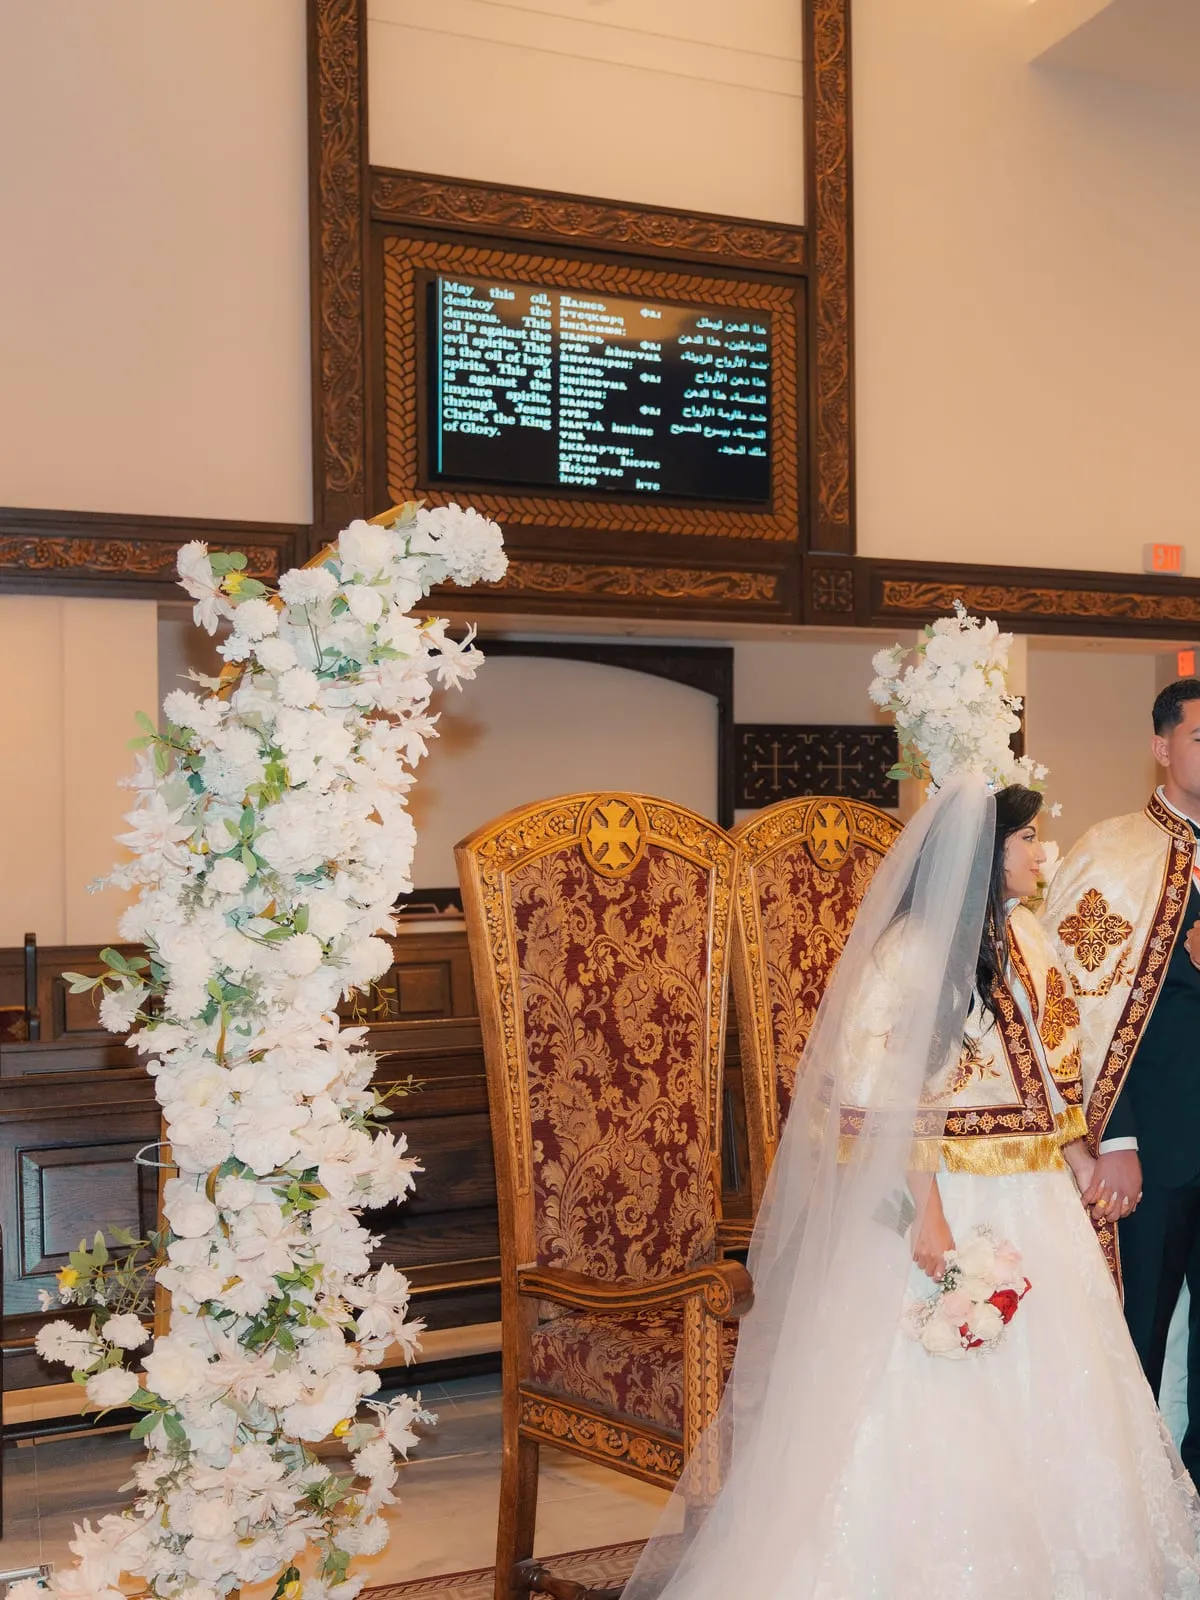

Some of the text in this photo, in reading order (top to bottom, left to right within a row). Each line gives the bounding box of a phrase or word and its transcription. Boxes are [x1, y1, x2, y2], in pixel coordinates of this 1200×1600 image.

[444, 281, 551, 306] May this oil,
[443, 294, 552, 317] destroy the
[443, 306, 552, 330] demons. This
[443, 320, 552, 342] oil is against the
[443, 333, 552, 354] evil spirits. This
[443, 344, 552, 368] is the oil of holy
[443, 359, 552, 379] spirits. This oil
[443, 369, 552, 391] is against the
[443, 382, 551, 406] impure spirits,
[443, 395, 552, 416] through Jesus
[443, 408, 552, 431] Christ, the King
[443, 421, 501, 437] of Glory.
[1153, 544, 1181, 571] EXIT
